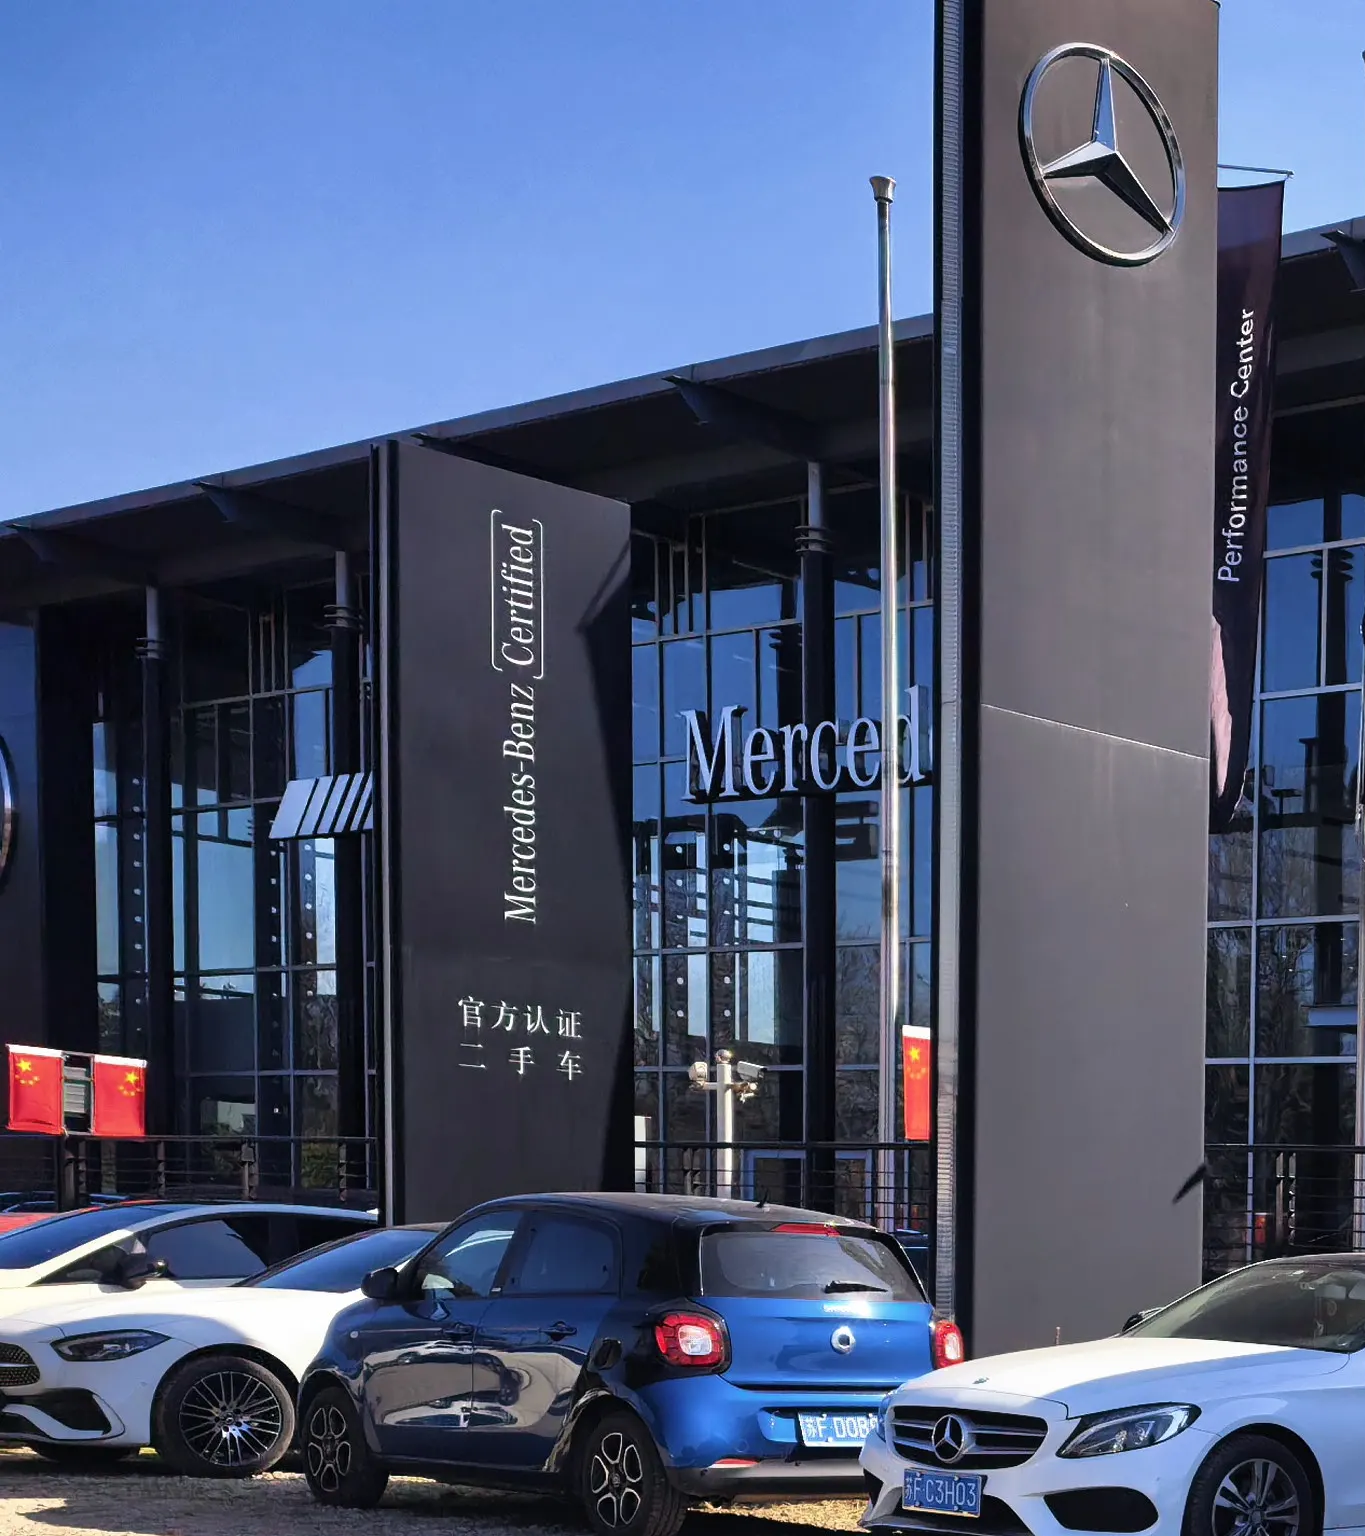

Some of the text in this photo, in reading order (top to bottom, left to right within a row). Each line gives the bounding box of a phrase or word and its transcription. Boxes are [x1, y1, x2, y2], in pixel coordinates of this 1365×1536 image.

[1217, 308, 1255, 582] Performance Center
[500, 524, 536, 924] Mercedes-Benz Certified
[679, 684, 932, 801] Merced
[458, 995, 583, 1039] 官方认证
[458, 1044, 584, 1081] 二手车
